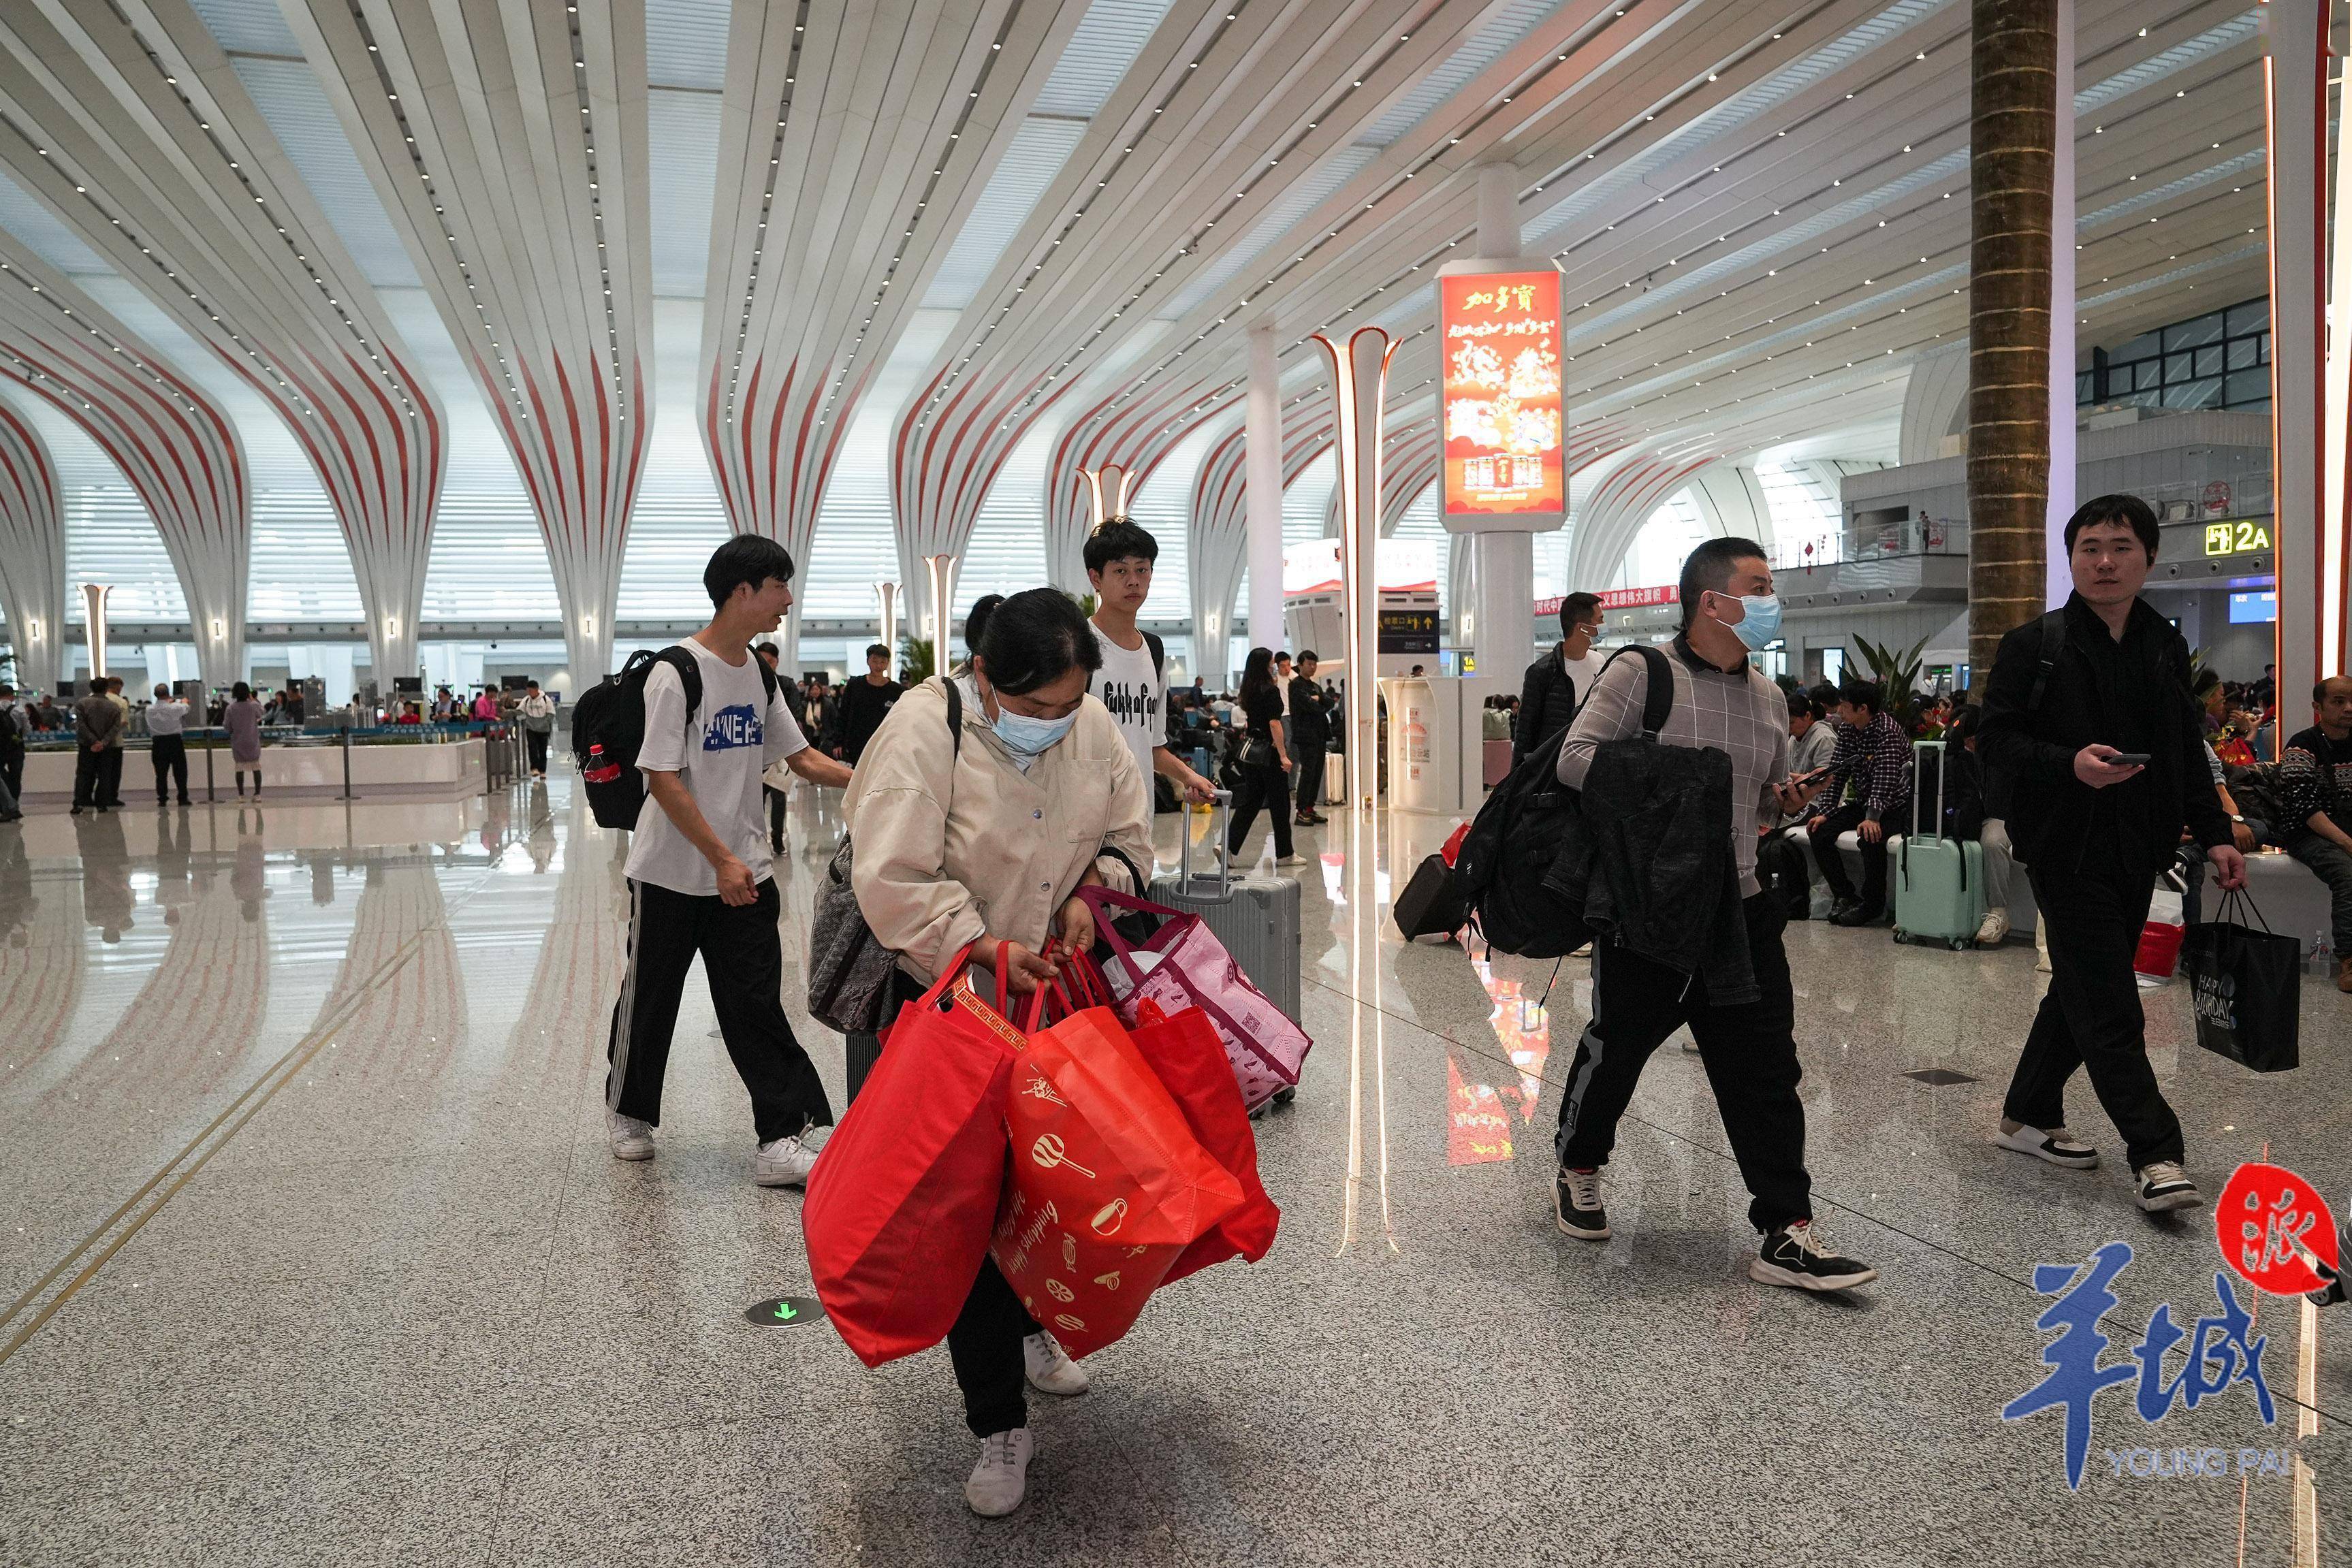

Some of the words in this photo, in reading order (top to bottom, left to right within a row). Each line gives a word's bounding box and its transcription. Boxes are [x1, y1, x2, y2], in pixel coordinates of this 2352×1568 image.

[2236, 522, 2269, 550] 2A
[2198, 974, 2223, 995] HAPPY
[1021, 1200, 1058, 1252] shopping
